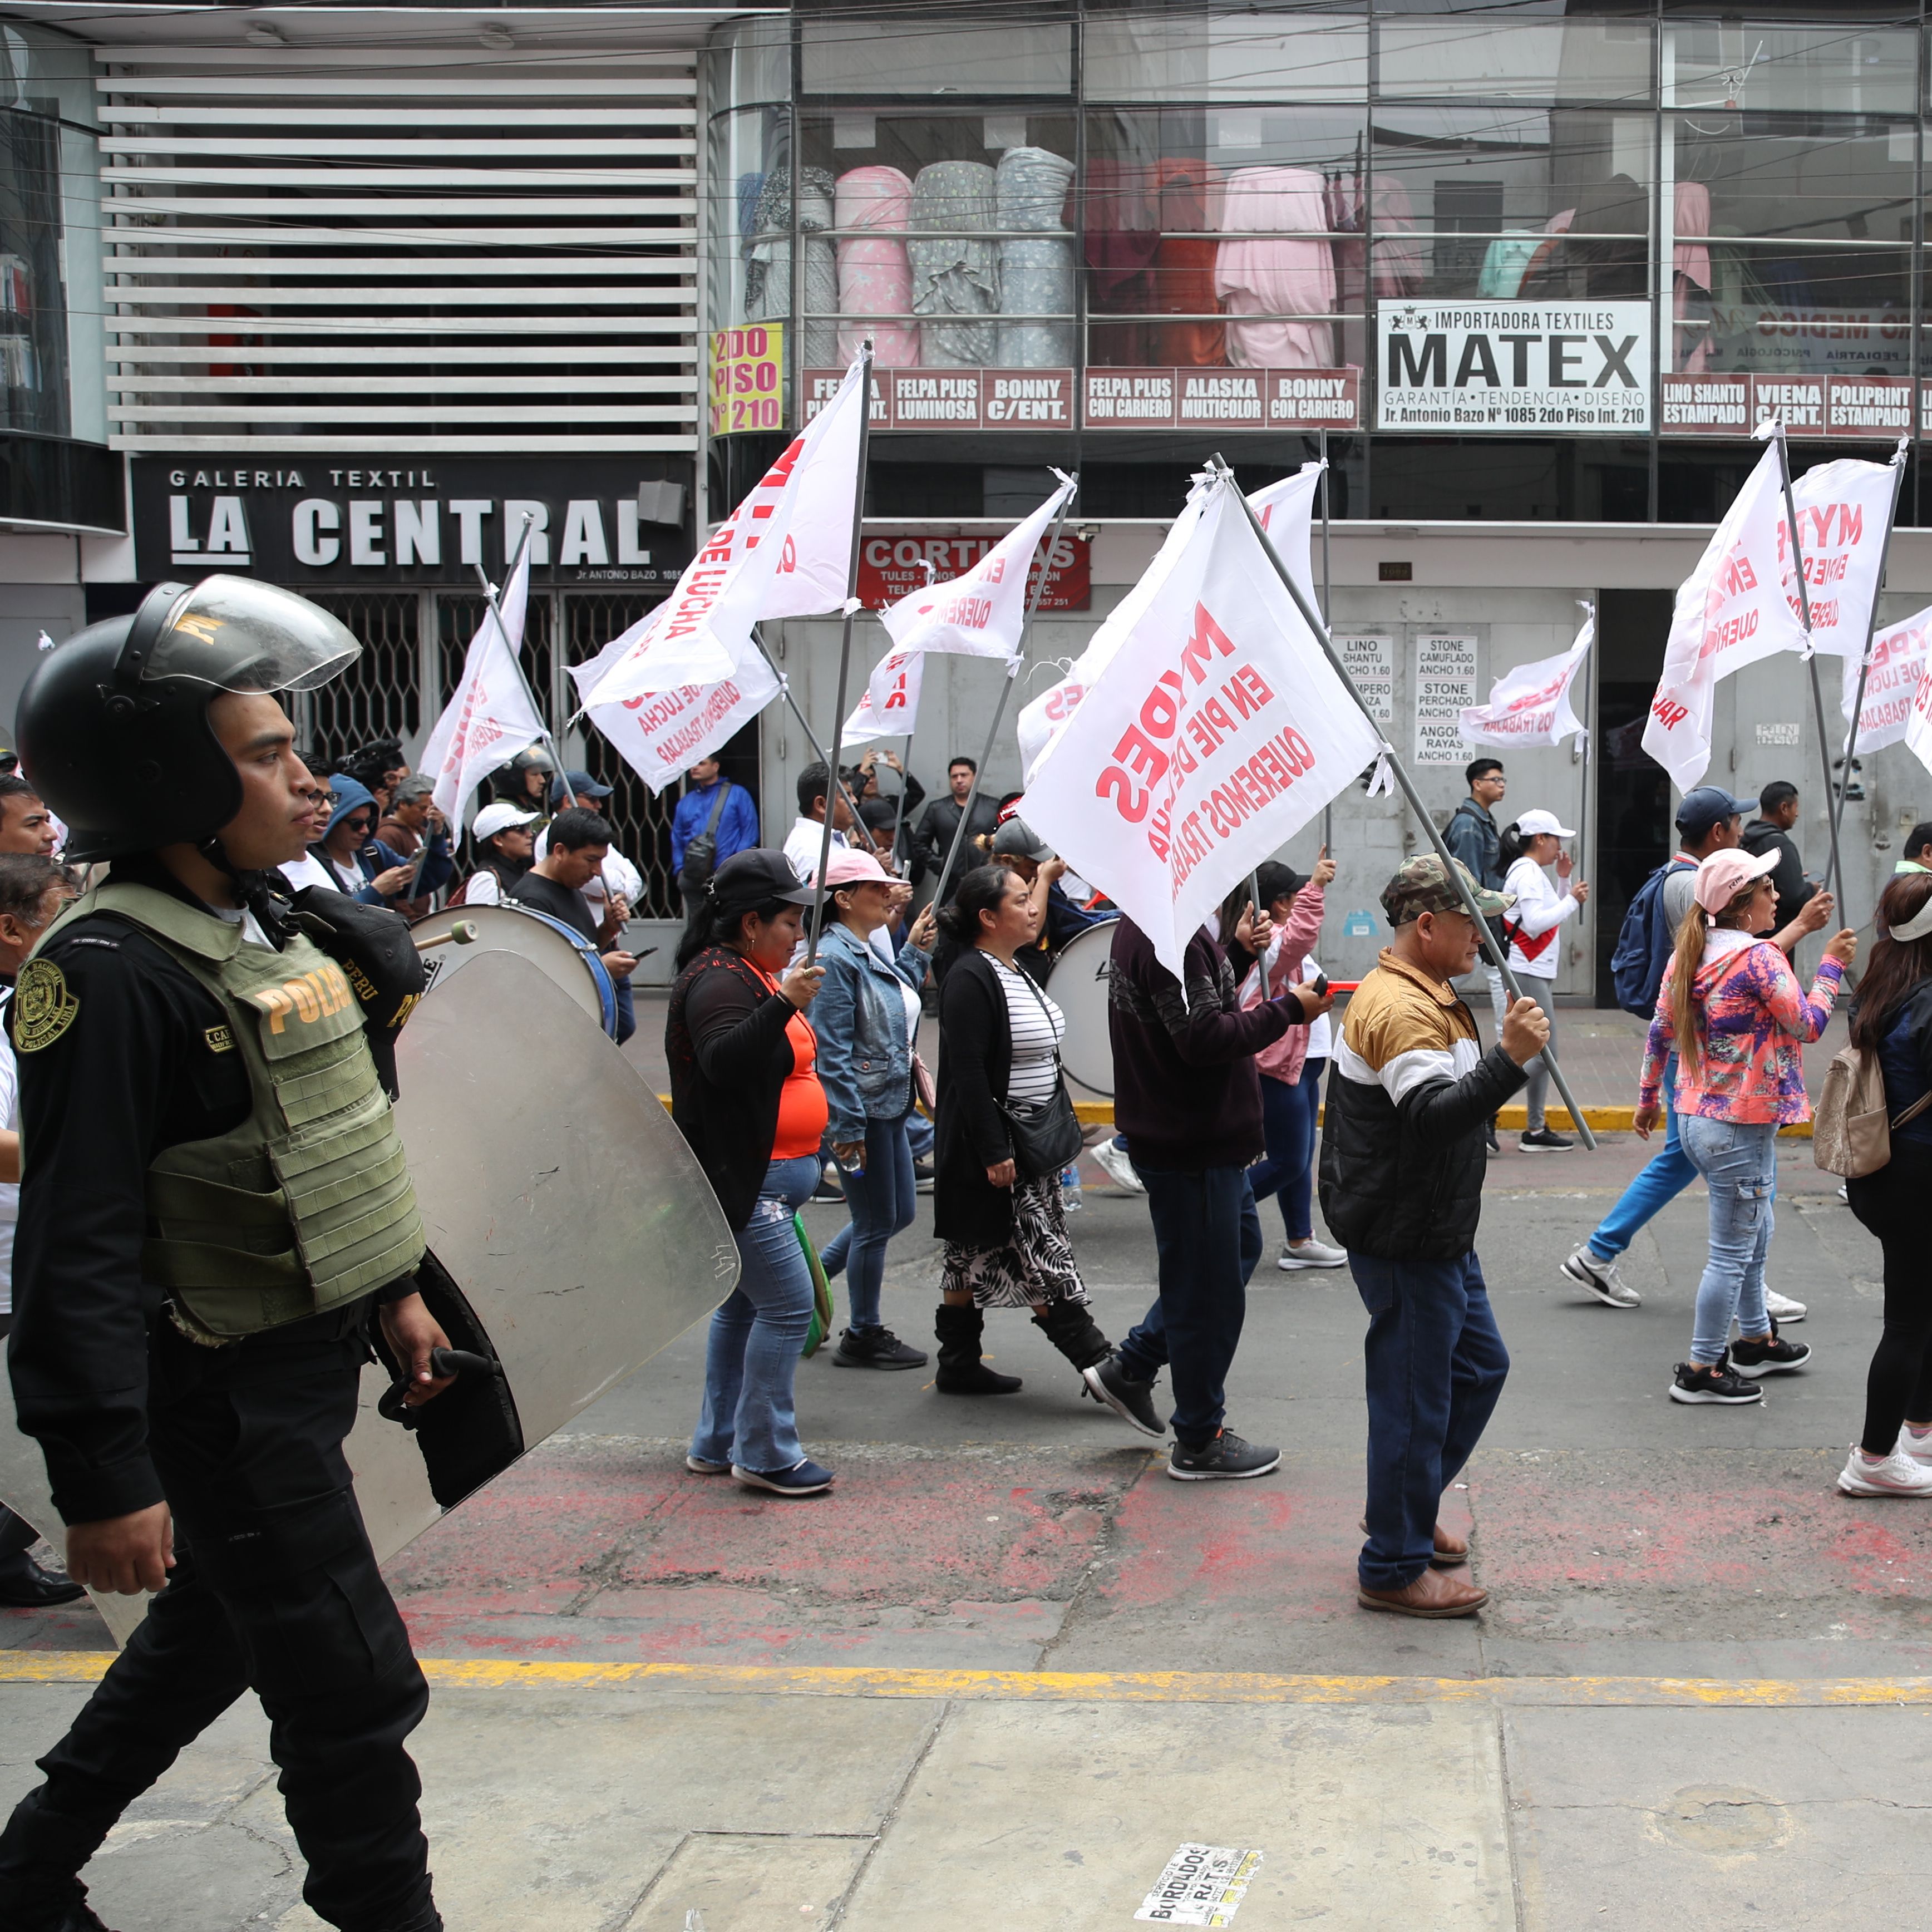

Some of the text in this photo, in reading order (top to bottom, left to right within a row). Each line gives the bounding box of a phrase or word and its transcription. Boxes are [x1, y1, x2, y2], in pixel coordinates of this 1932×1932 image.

[1436, 312, 1614, 330] IMPORTADORA TEXTILES
[716, 327, 767, 363] 2DO
[1388, 333, 1640, 388] MATEX
[716, 362, 777, 398] PISO
[814, 379, 880, 398] FEA
[897, 379, 978, 398] FELPA PLUS
[995, 379, 1061, 399] BONNY
[1088, 378, 1172, 397] FELPA PLUS
[1186, 378, 1258, 398] ALASKA
[1279, 379, 1346, 398] BONNY
[1478, 392, 1571, 406] TENDENCIA
[1584, 390, 1645, 407] DISEÑO
[1664, 383, 1746, 404] LINO SHANTU
[1757, 385, 1822, 405] VIENA
[1831, 386, 1911, 406] POLIPRINT
[732, 398, 779, 430] 210
[898, 400, 978, 420] LUMINOSA
[988, 401, 1067, 420] C/ENT.
[1088, 399, 1172, 418] CON CARNERO
[1181, 400, 1261, 418] MULTICOLOR
[1271, 400, 1354, 420] CON CARNERO
[1384, 408, 1398, 423] Jr.
[1400, 408, 1452, 423] Antonio
[1455, 409, 1484, 423] Bazo
[1506, 408, 1536, 423] 1085
[1539, 408, 1564, 423] 2do
[1567, 408, 1594, 423] Piso
[1598, 408, 1619, 423] Int.
[1622, 409, 1645, 423] 210
[1664, 405, 1746, 424] ESTAMPADO
[1756, 406, 1822, 426] C/ENT.
[1831, 407, 1910, 427] ESTAMPADO
[170, 470, 436, 487] GALERIA TEXTIL
[170, 495, 650, 566] LA CENTRAL
[865, 540, 1076, 568] CORTIAS
[576, 570, 587, 580] Jr.
[589, 570, 629, 580] ANTONIO
[631, 570, 657, 580] BAZO
[880, 571, 915, 581] TULES
[1030, 585, 1054, 595] EC.
[664, 569, 727, 641] LUCHA
[1347, 641, 1377, 652] LINO
[1431, 640, 1464, 652] STONE
[1343, 653, 1382, 663] SHANTU
[1420, 653, 1474, 663] CAMUFLADO
[1373, 666, 1391, 676] 1.60
[1420, 665, 1475, 676] ANCHO 1.60
[1425, 683, 1468, 694] STONE
[1419, 696, 1473, 707] PERCHADO
[1372, 708, 1390, 718] 1.60
[1418, 708, 1453, 718] ANCHO
[1427, 739, 1464, 749] RAYAS
[1418, 751, 1473, 761] ANCHO 1.60
[342, 958, 379, 1002] PERU
[1149, 1846, 1209, 1919] BORDADOS
